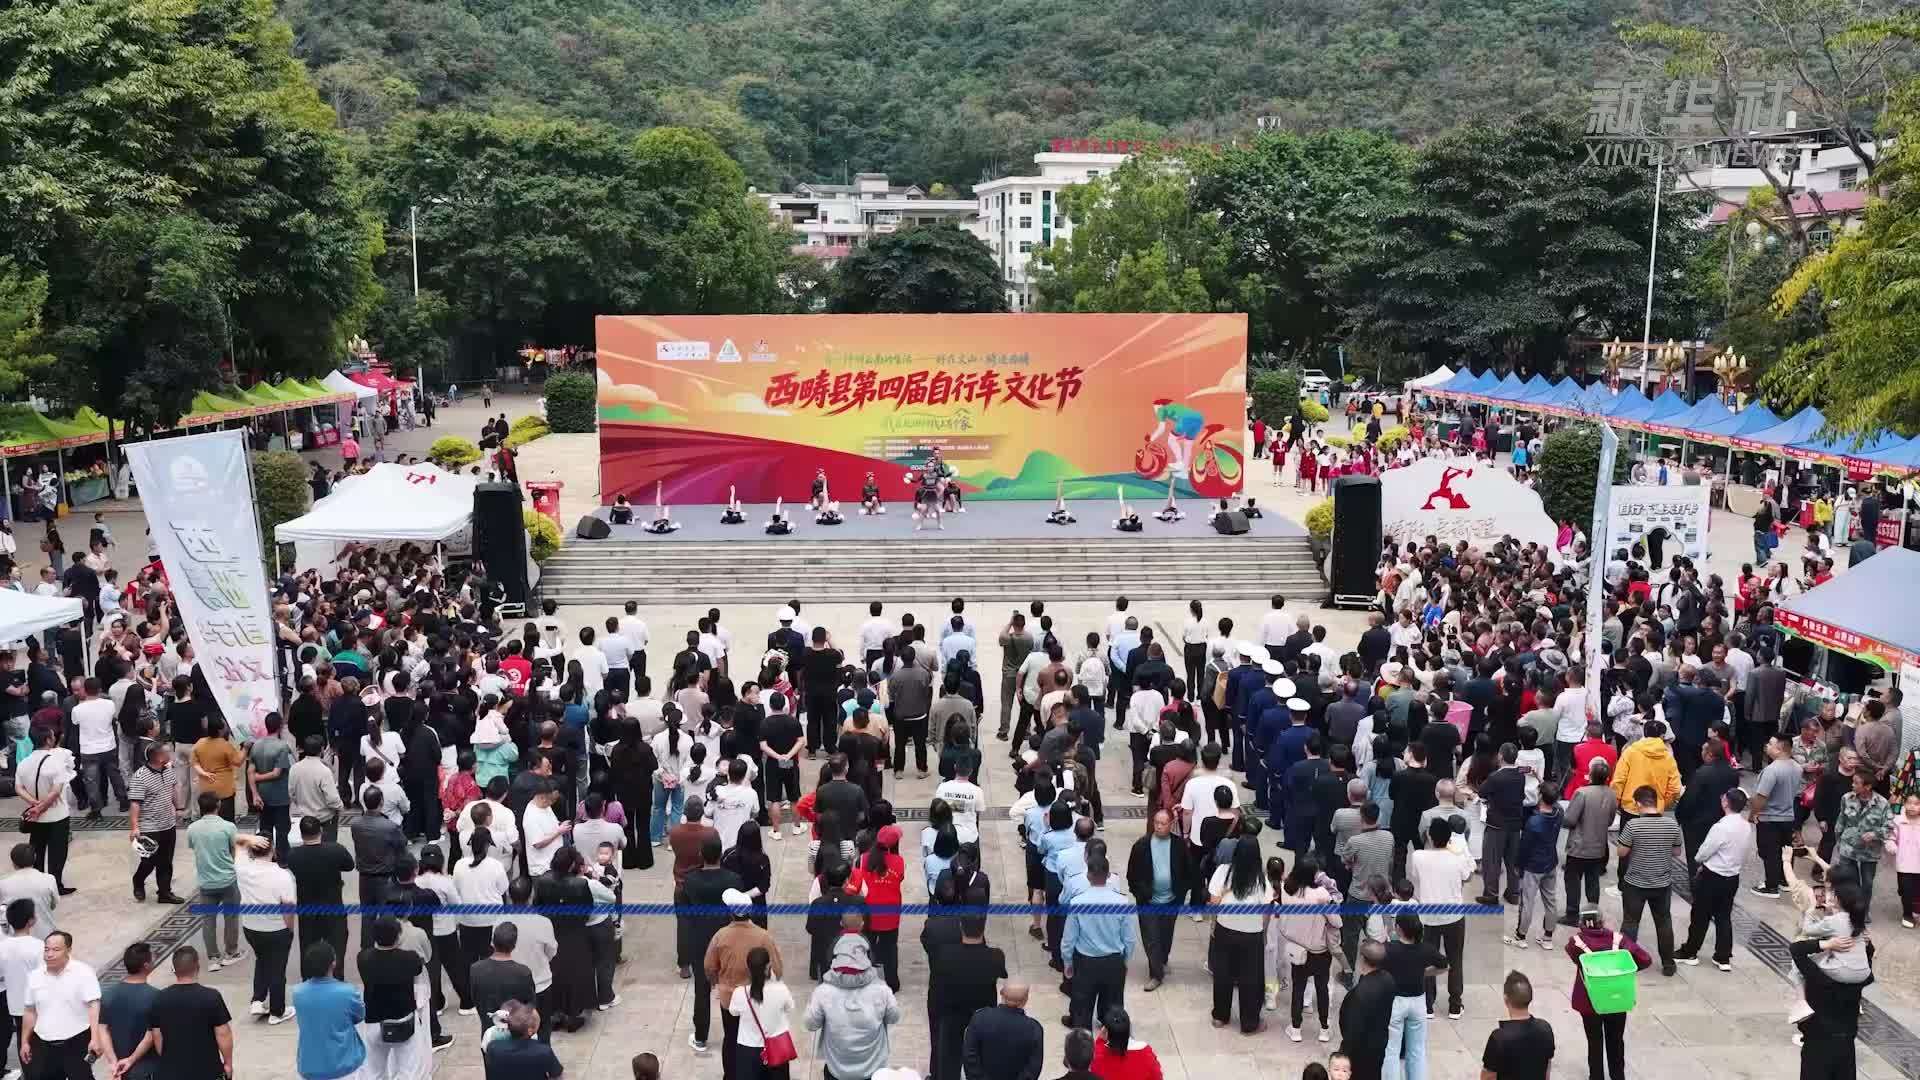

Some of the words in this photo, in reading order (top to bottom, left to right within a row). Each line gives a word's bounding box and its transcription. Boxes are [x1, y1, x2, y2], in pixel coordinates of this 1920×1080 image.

[764, 366, 1084, 416] 西畴县第四届自行车文化节
